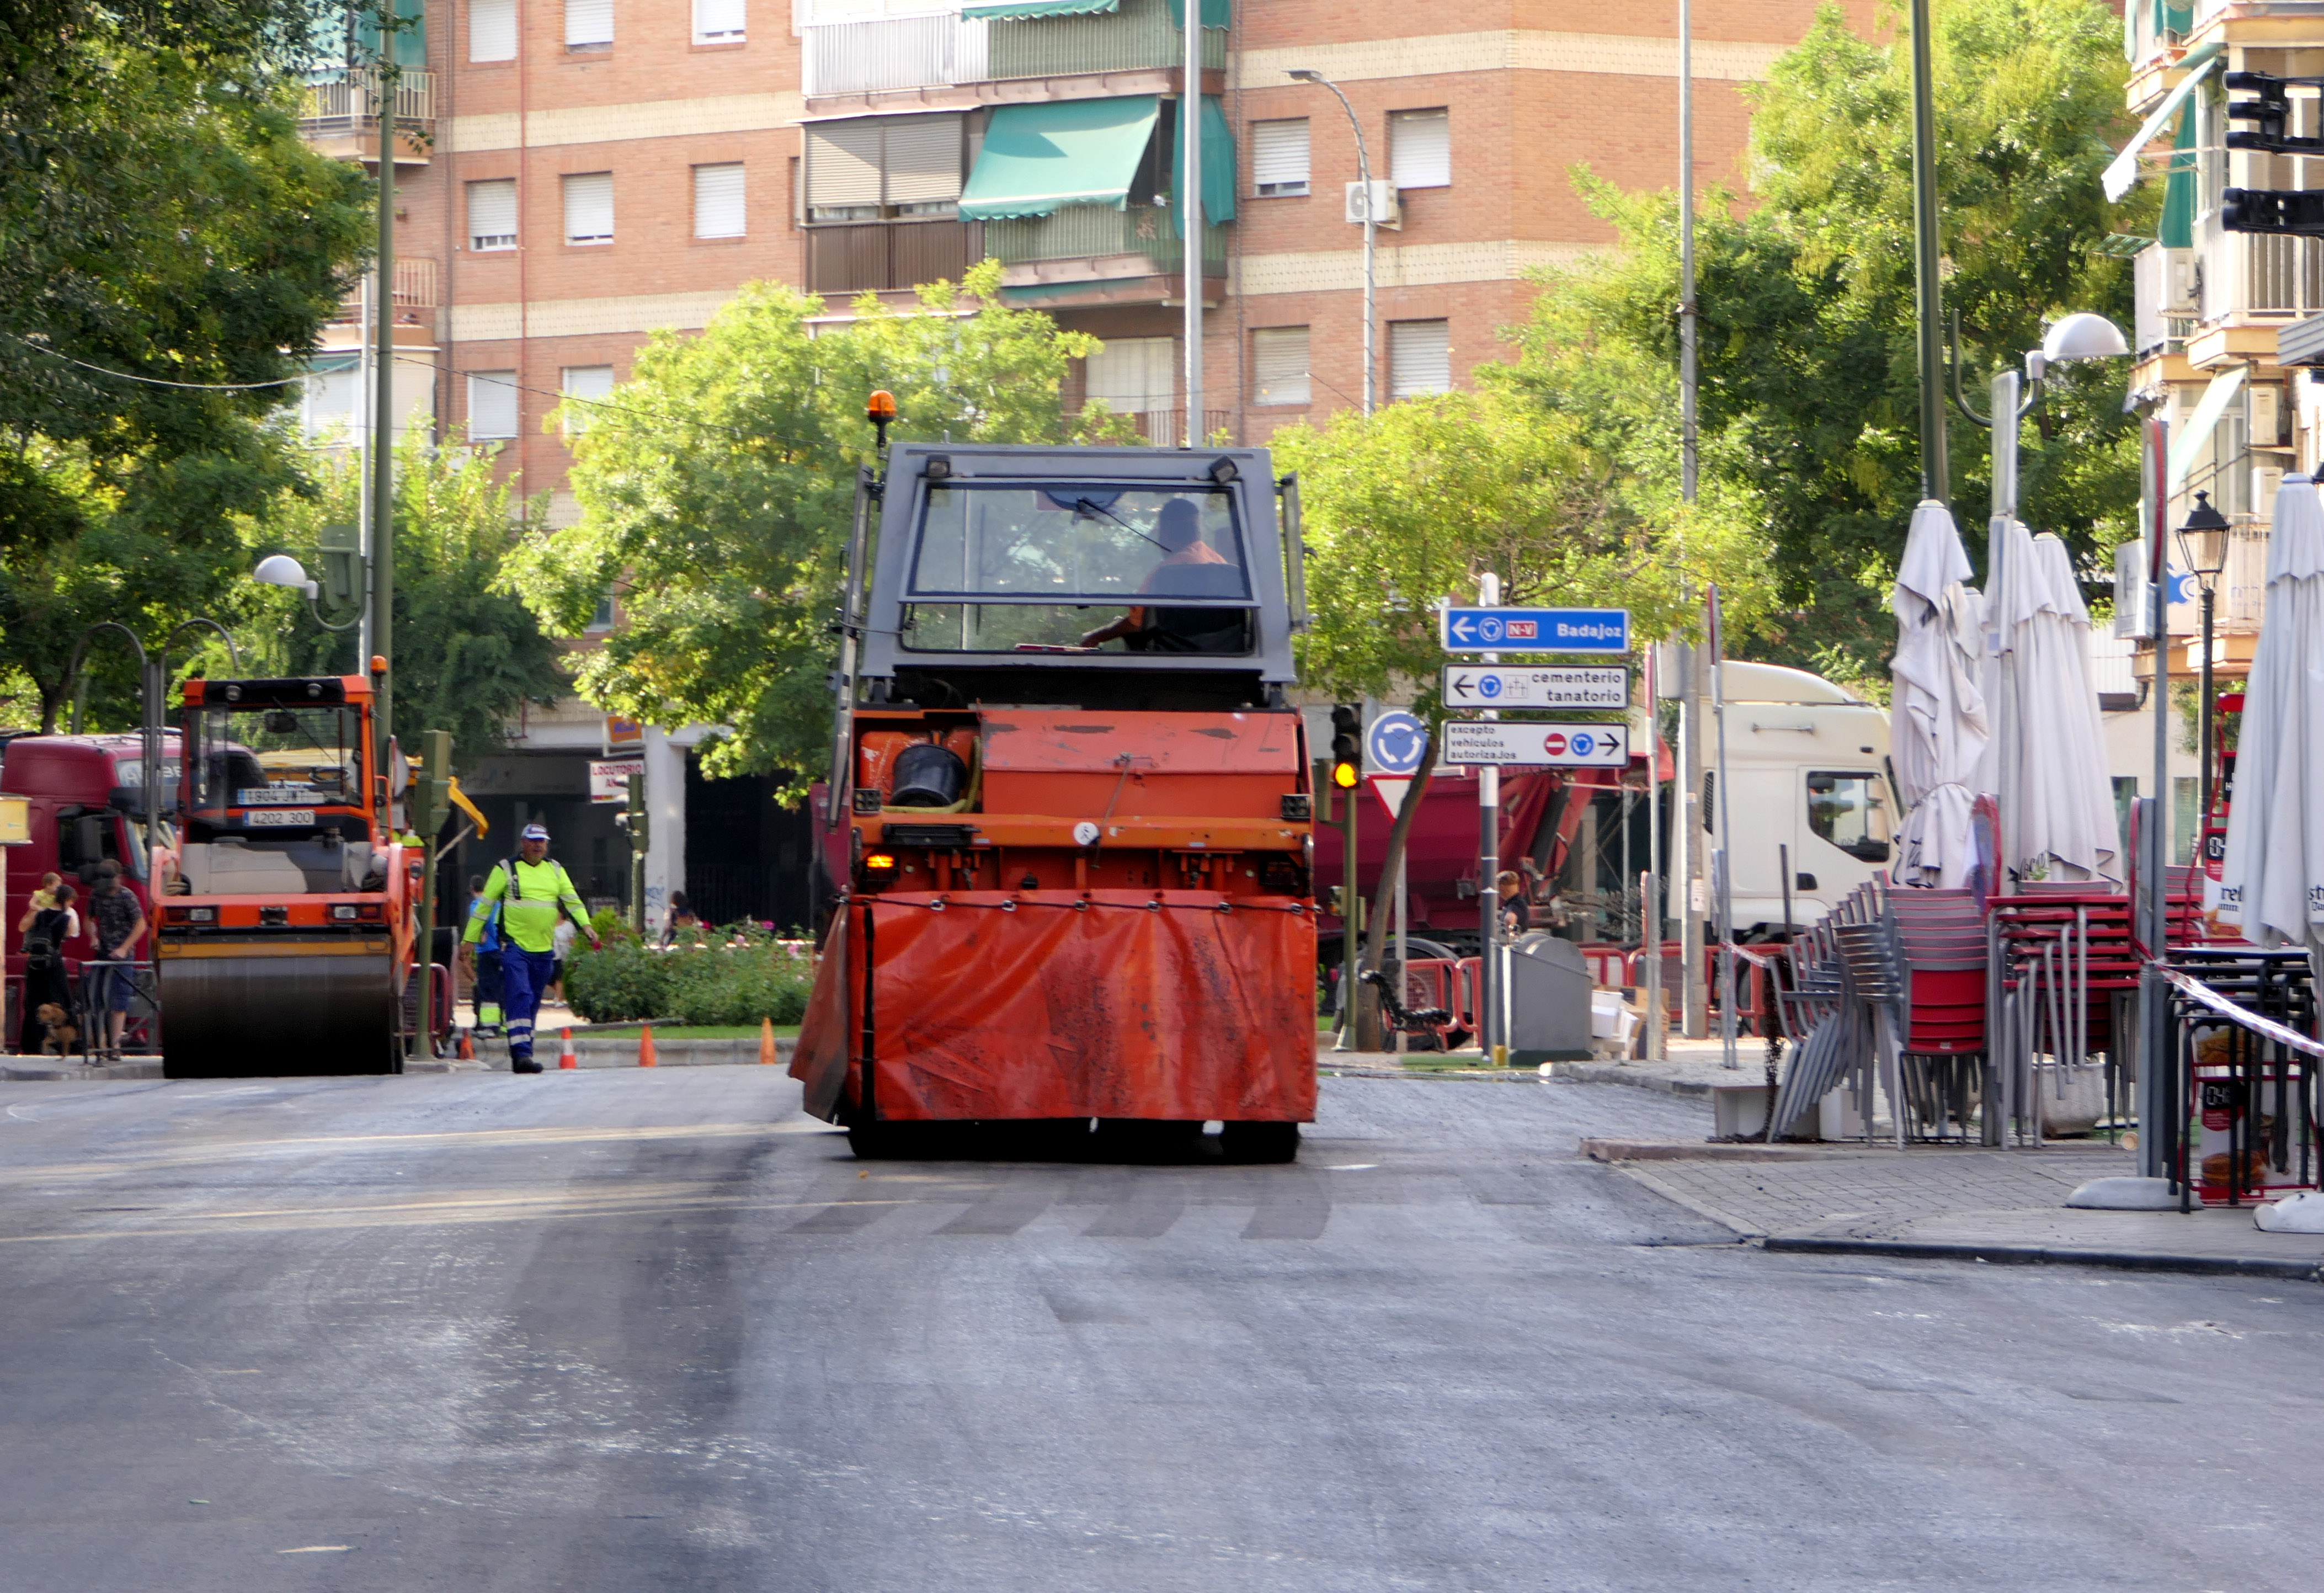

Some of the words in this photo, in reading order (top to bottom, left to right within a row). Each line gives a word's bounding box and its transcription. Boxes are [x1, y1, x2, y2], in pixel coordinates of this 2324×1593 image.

[1509, 624, 1534, 635] N-V
[1557, 623, 1622, 640] Badajoz
[1532, 671, 1621, 684] cementerio
[1547, 689, 1621, 702] tanatorio
[1451, 726, 1495, 734] excepto
[592, 764, 642, 776] LOCUTORIO
[253, 813, 283, 824] 4202
[290, 812, 311, 823] 300
